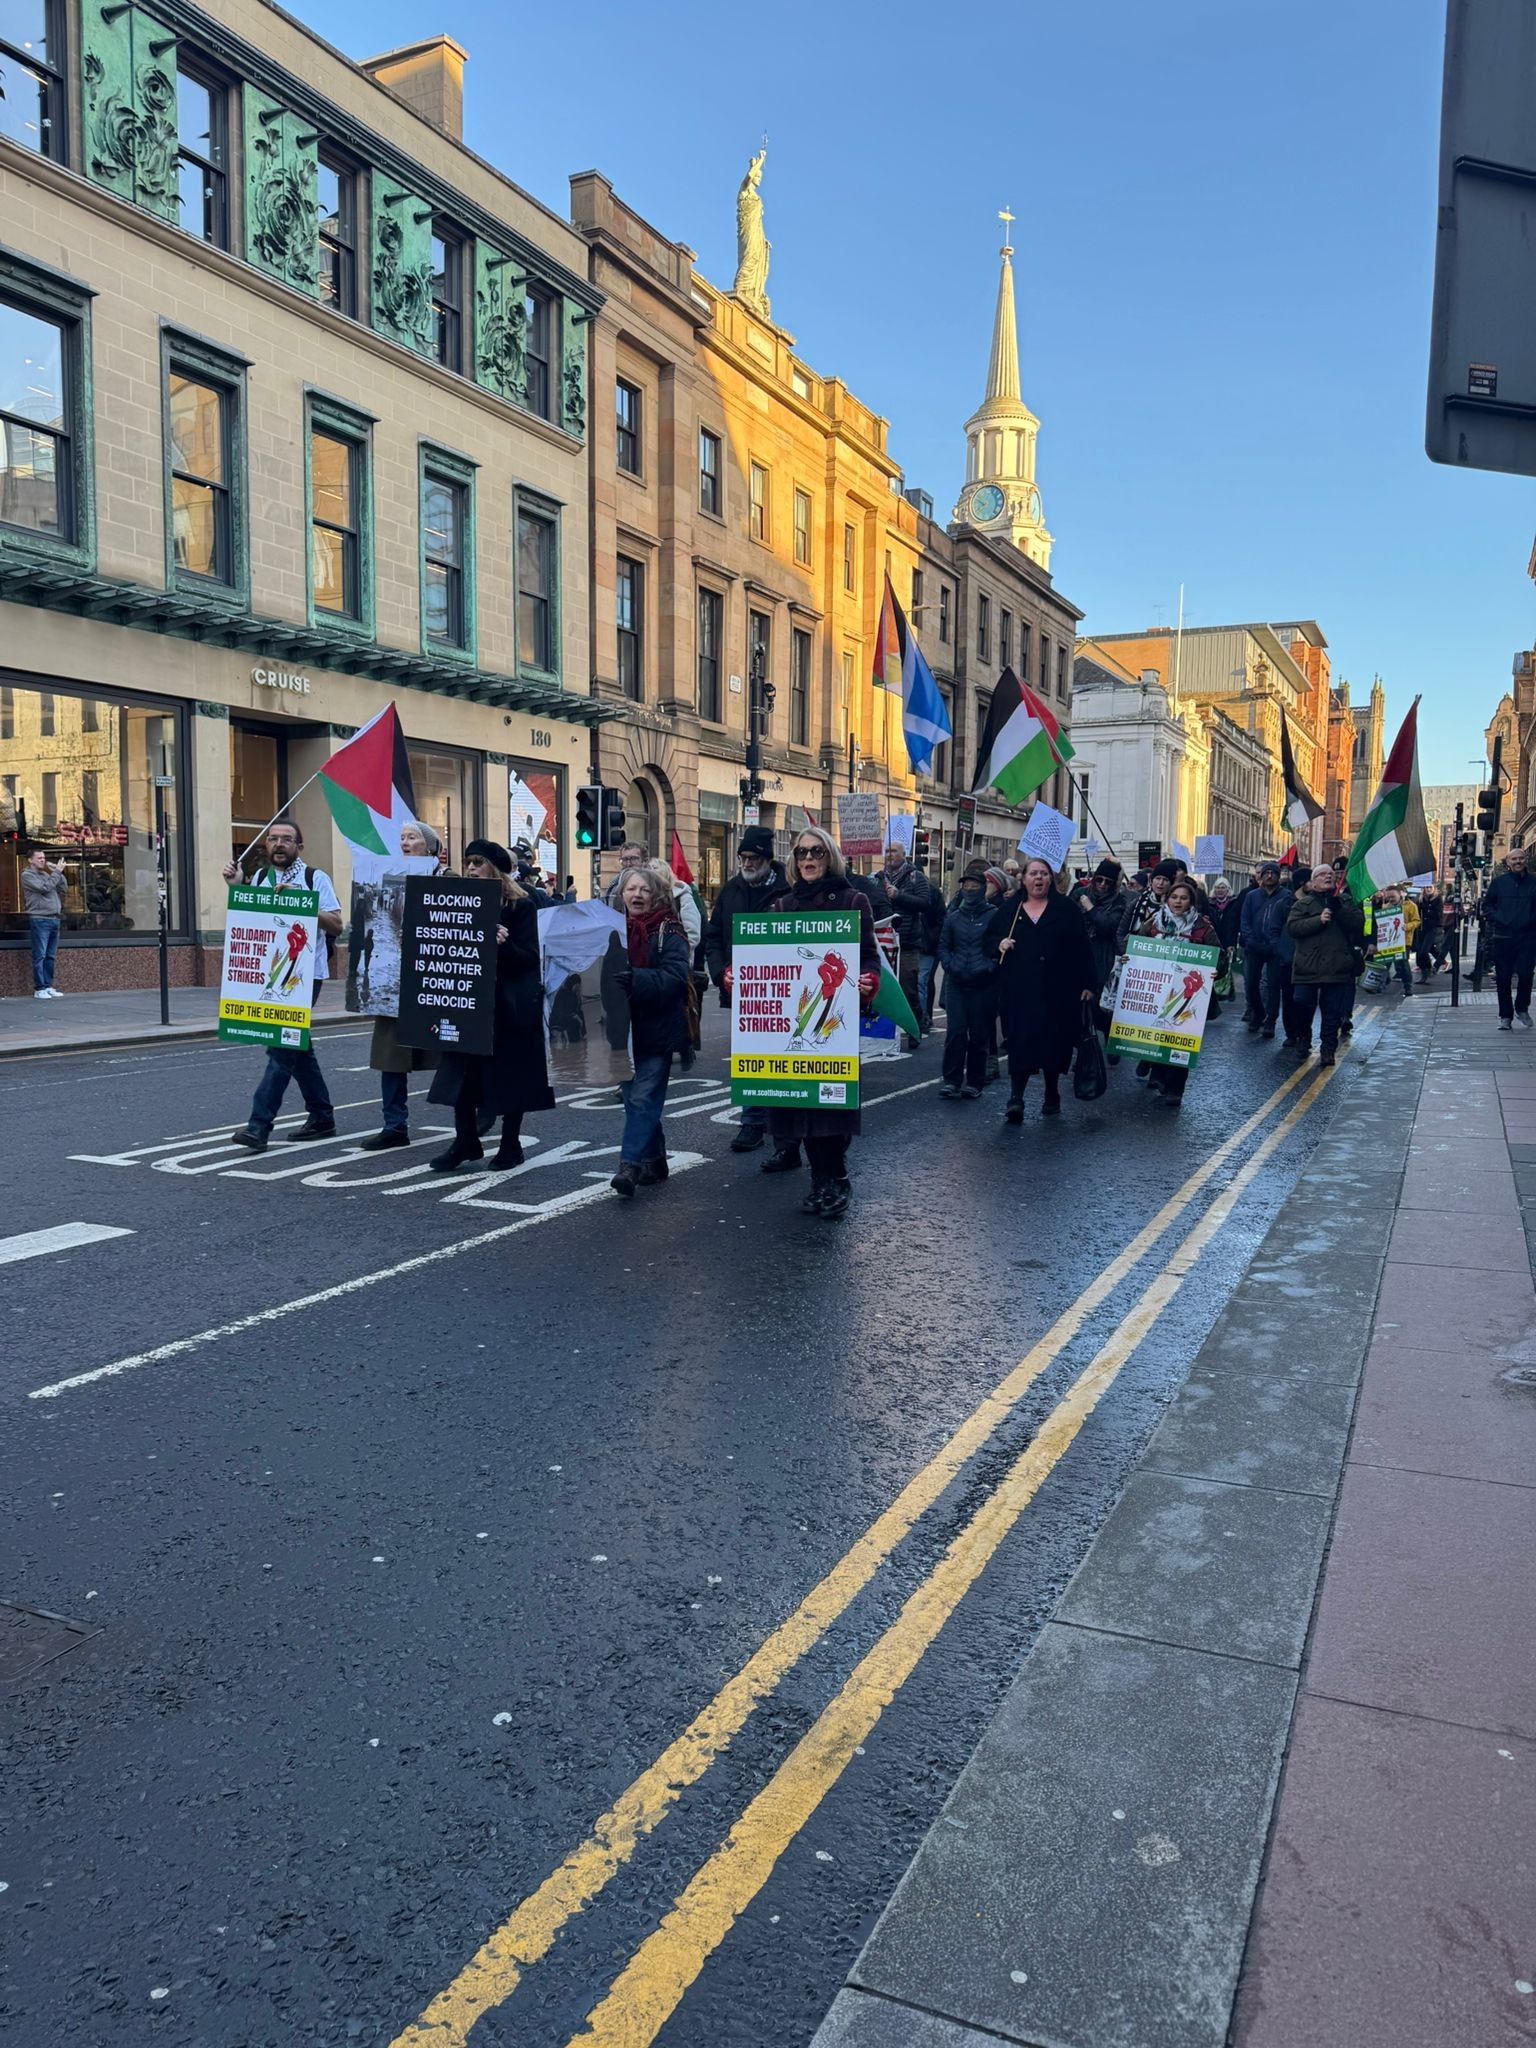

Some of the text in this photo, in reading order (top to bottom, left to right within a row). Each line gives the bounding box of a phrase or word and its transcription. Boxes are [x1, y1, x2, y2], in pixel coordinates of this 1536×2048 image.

[252, 668, 311, 693] CRUISE
[530, 728, 552, 748] 180
[57, 823, 128, 846] SALE
[233, 891, 313, 909] FREE THE FILTON 24
[423, 893, 482, 908] BLOCKING
[429, 911, 473, 925] WINTER
[231, 927, 277, 943] SOLIDARITY
[416, 927, 485, 942] ESSENTIALS
[740, 919, 851, 935] FREE THE FILTON 24
[230, 941, 267, 957] WITH THE
[419, 943, 480, 959] INTO GAZA
[1132, 940, 1212, 960] FREE THE FILTON 24
[228, 955, 260, 970] HUNGER
[415, 960, 482, 976] IS ANOTHER
[227, 969, 265, 985] STRIKERS
[739, 965, 802, 981] SOLIDARITY
[1126, 968, 1173, 984] SOLIDARITY
[422, 977, 473, 992] FORM OF
[739, 983, 791, 998] WITH THE
[1125, 979, 1162, 994] WITH THE
[417, 993, 476, 1009] GENOCIDE
[1122, 990, 1155, 1003] HUNGER
[225, 1003, 306, 1024] STOP THE GENOCIDE!
[739, 1000, 782, 1015] HUNGER
[1120, 1000, 1159, 1015] STRIKERS
[738, 1017, 791, 1033] STRIKERS
[1115, 1026, 1196, 1048] STOP THE GENOCIDE!
[738, 1059, 851, 1075] STOP THE GENOCIDE!
[742, 1088, 809, 1098] www.scottishpsc.org.uk
